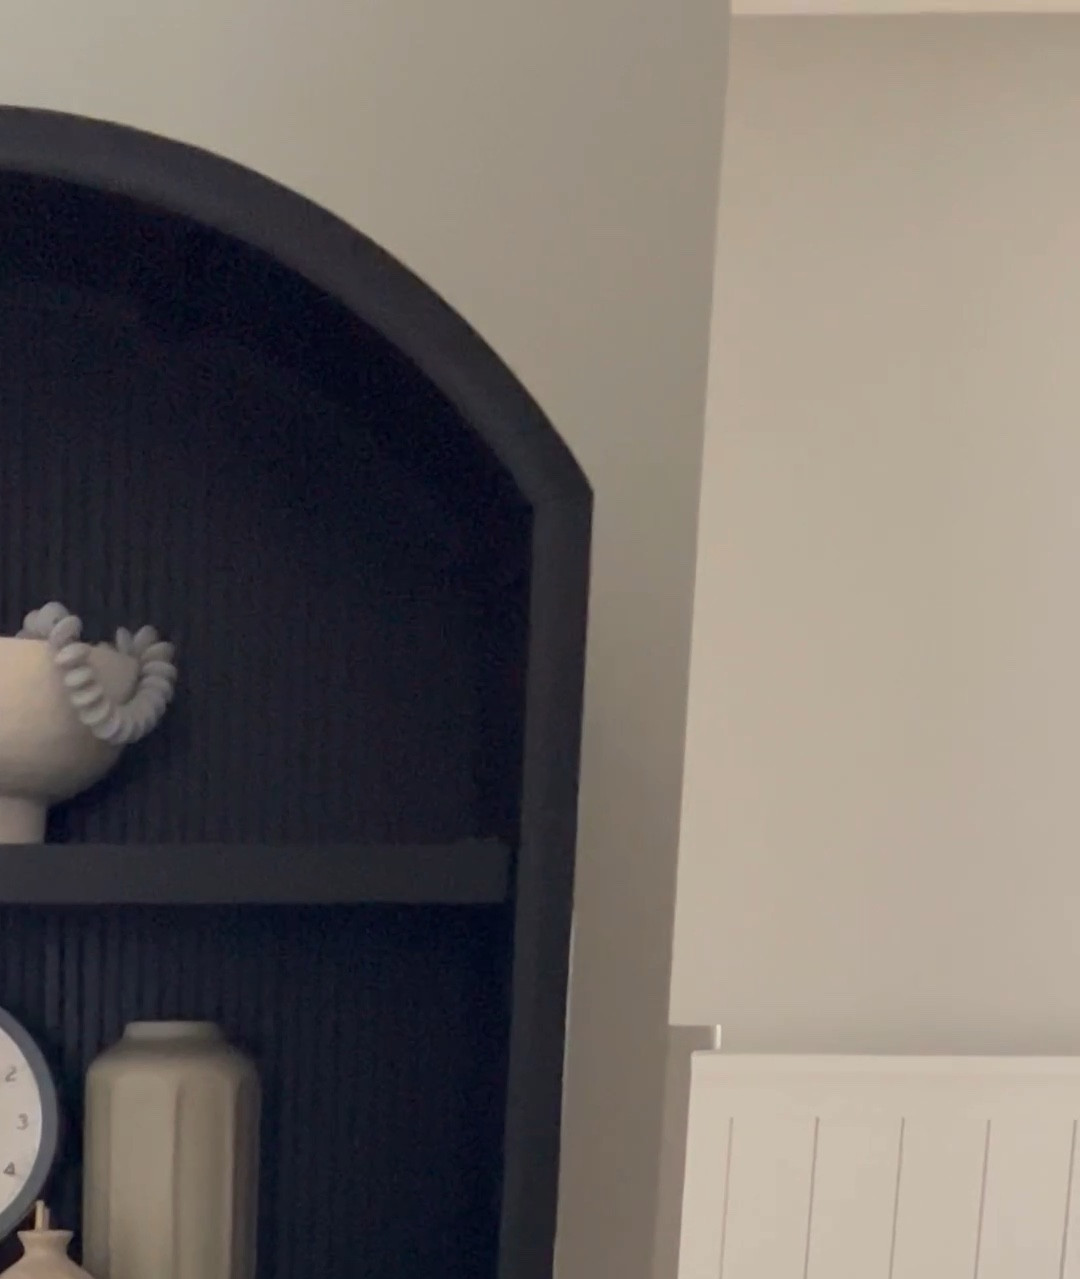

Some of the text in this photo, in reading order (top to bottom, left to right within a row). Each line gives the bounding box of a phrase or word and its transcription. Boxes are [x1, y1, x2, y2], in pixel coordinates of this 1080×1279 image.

[5, 1067, 17, 1082] 2
[17, 1113, 29, 1130] 3
[3, 1161, 16, 1176] 4
